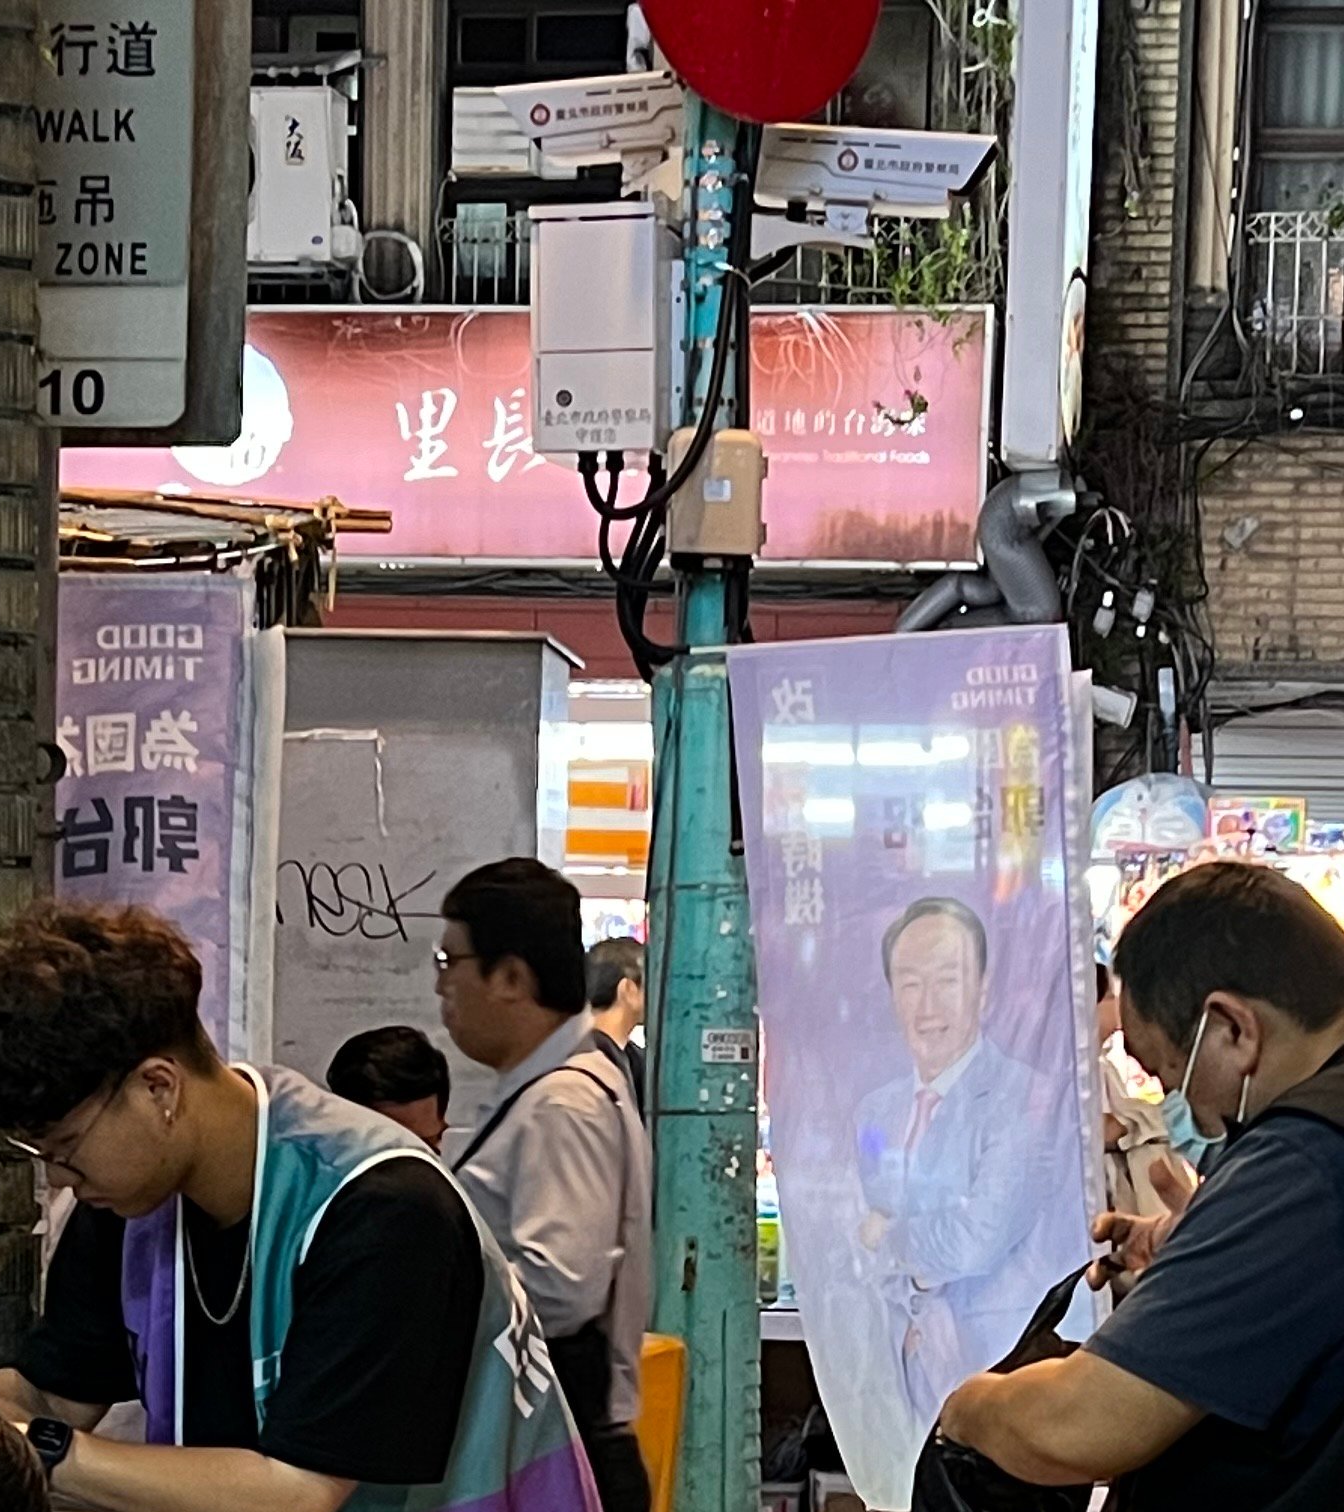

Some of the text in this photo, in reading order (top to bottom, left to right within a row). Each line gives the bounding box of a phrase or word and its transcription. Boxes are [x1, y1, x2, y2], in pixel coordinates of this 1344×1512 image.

[50, 21, 157, 76] 行道
[34, 108, 136, 143] WALK
[55, 242, 148, 276] ZONE
[38, 368, 106, 417] 10
